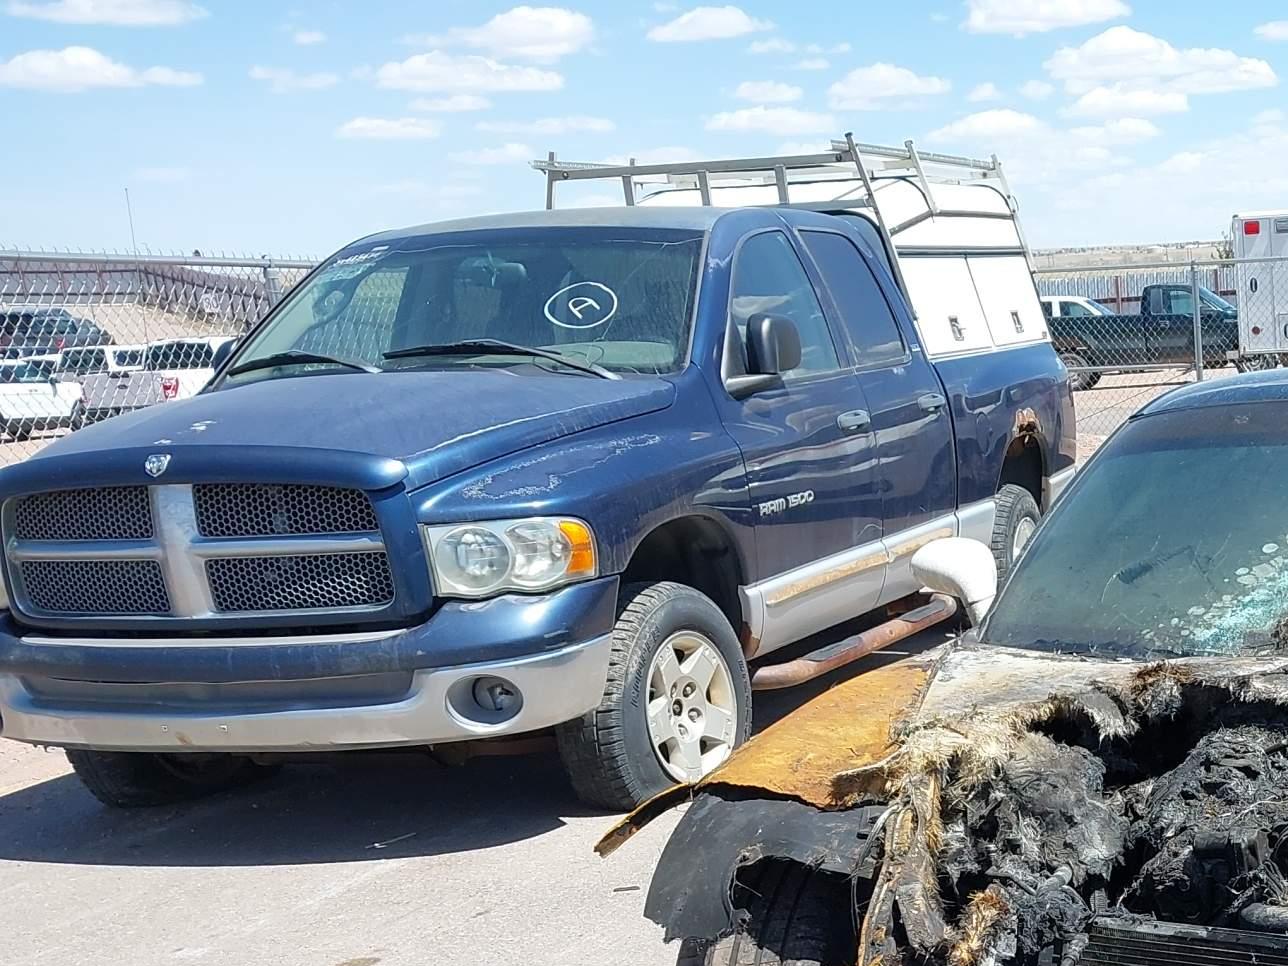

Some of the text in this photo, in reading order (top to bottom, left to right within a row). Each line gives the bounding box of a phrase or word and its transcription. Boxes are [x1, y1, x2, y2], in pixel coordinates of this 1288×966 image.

[567, 296, 601, 320] A
[759, 489, 815, 517] RAM 1500
